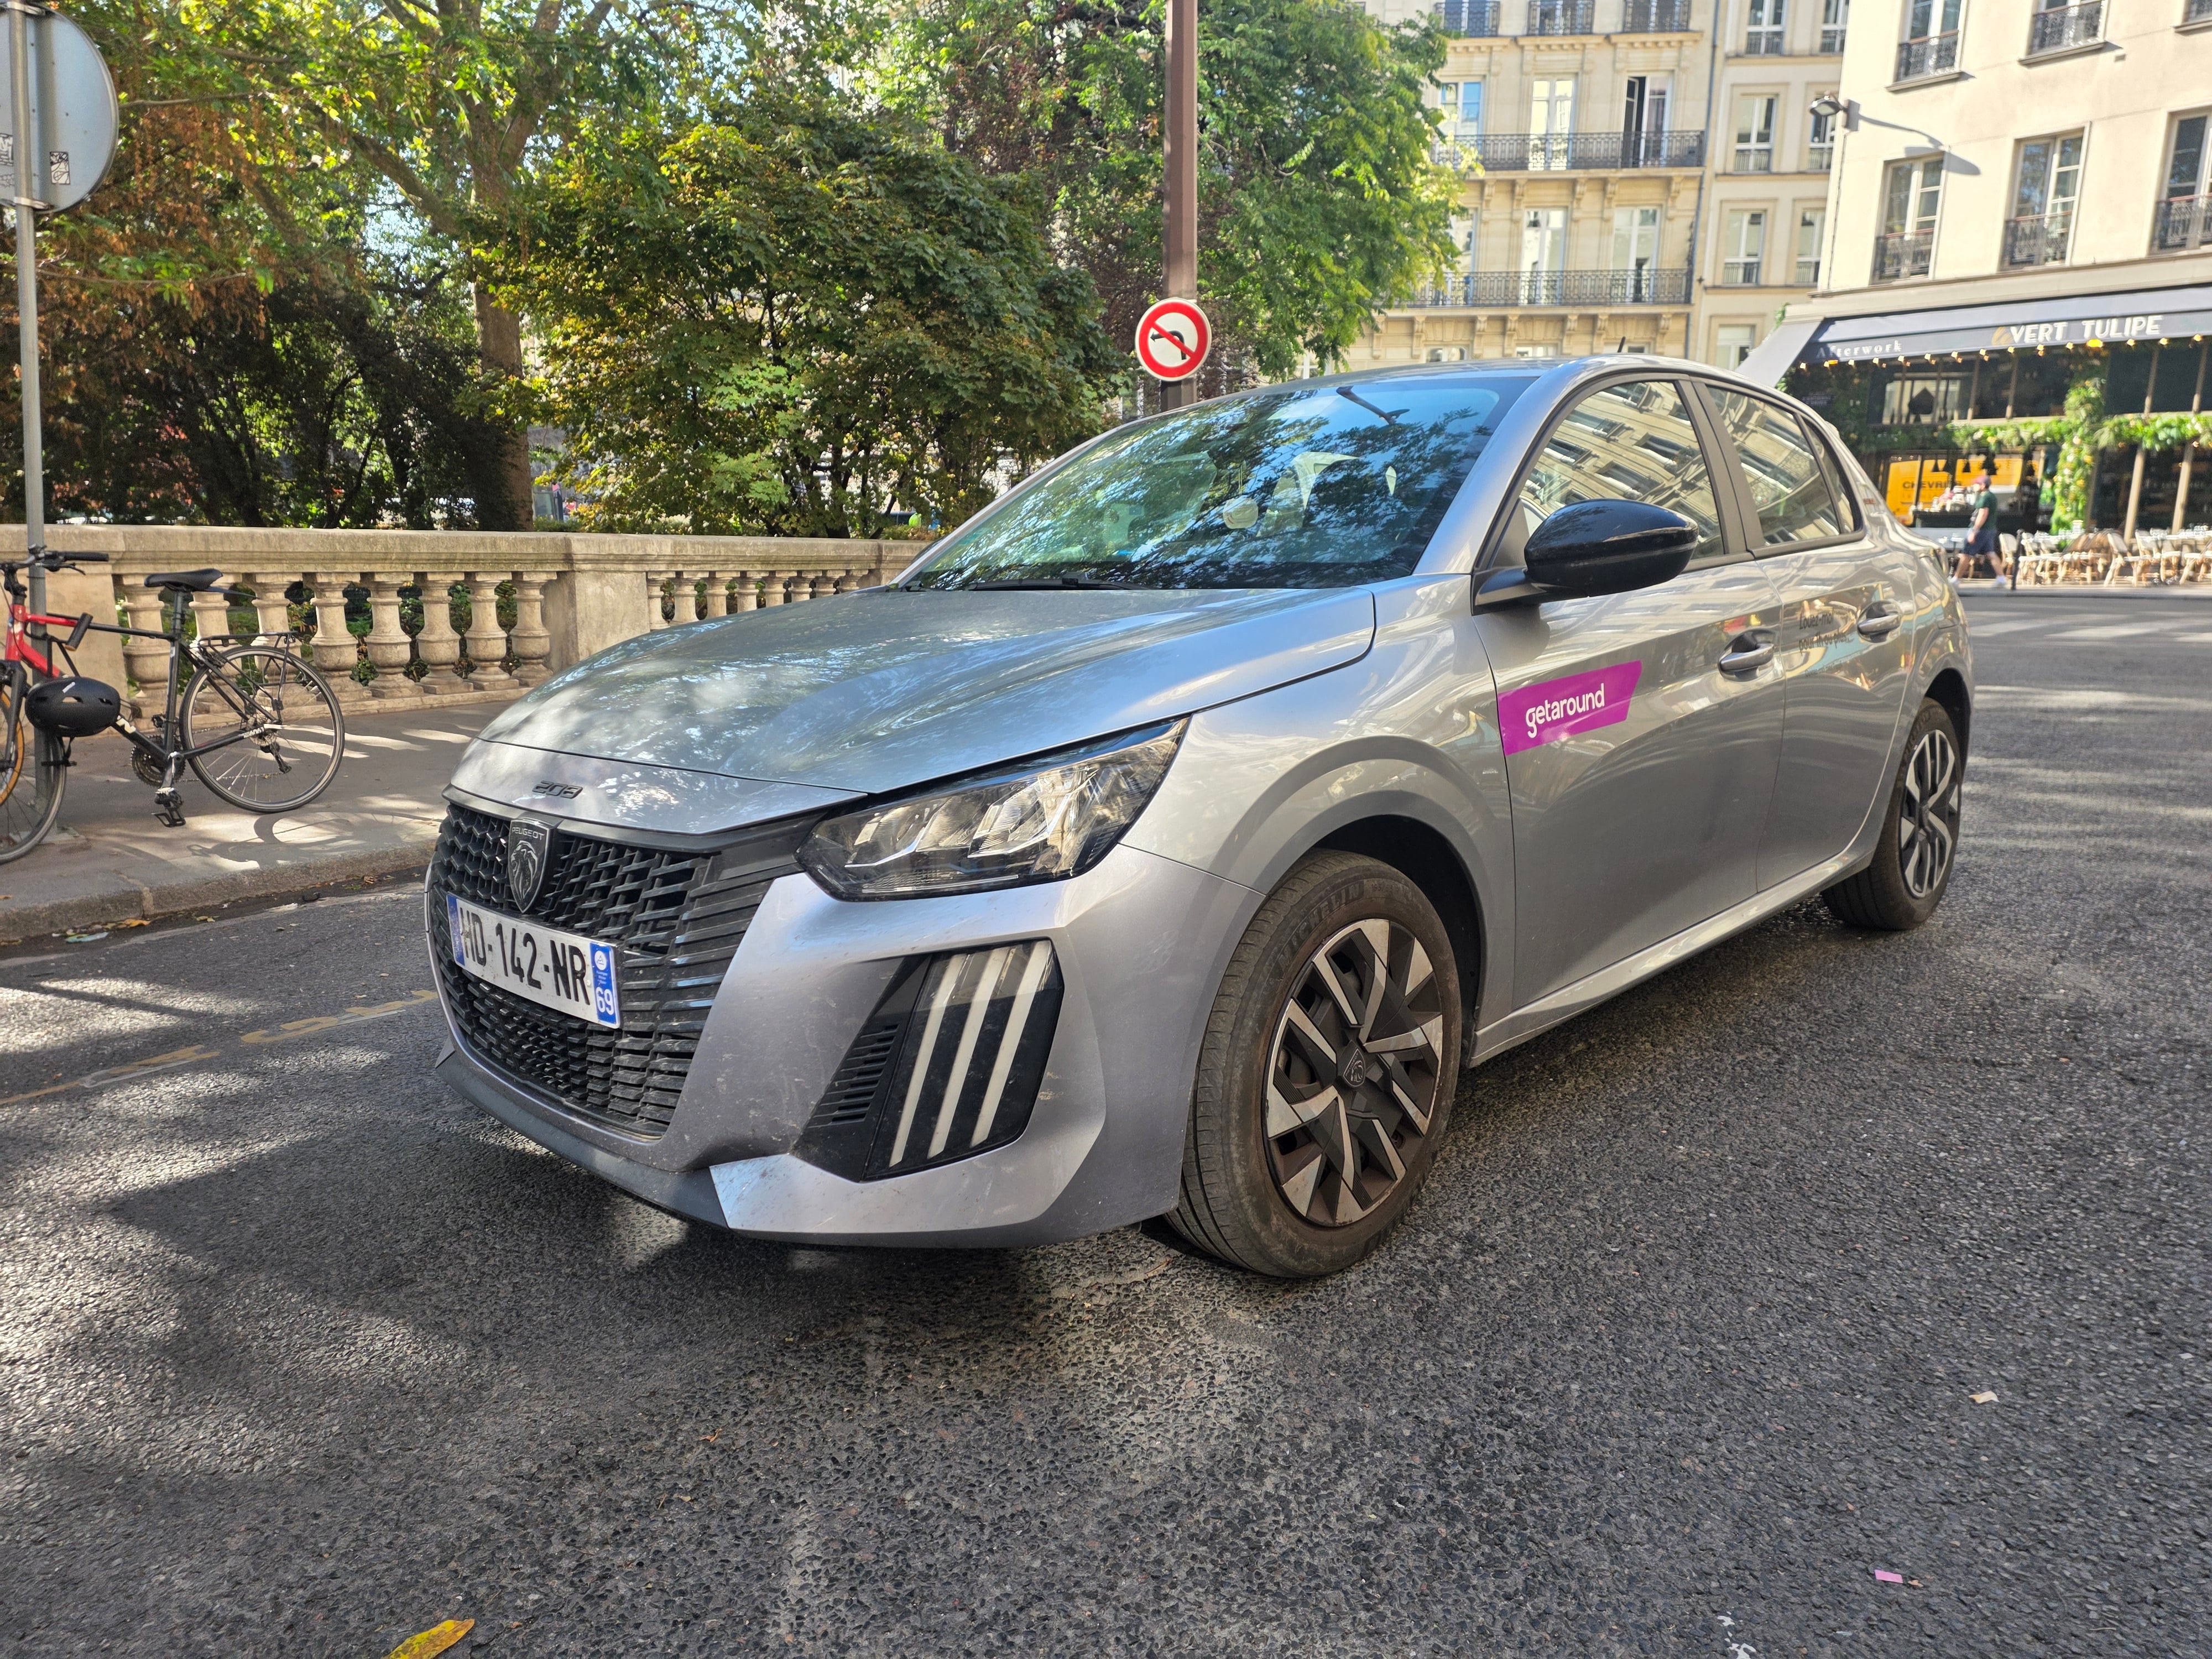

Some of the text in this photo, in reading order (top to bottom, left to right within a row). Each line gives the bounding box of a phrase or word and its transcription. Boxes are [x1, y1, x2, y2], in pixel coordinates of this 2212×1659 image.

[2010, 322, 2068, 343] VERT
[2082, 315, 2163, 339] TULIPE
[1816, 340, 1902, 358] Afterwork
[1526, 683, 1605, 738] getaround
[532, 780, 583, 799] 208
[512, 827, 545, 841] PEUGEOT
[596, 987, 614, 1015] 69
